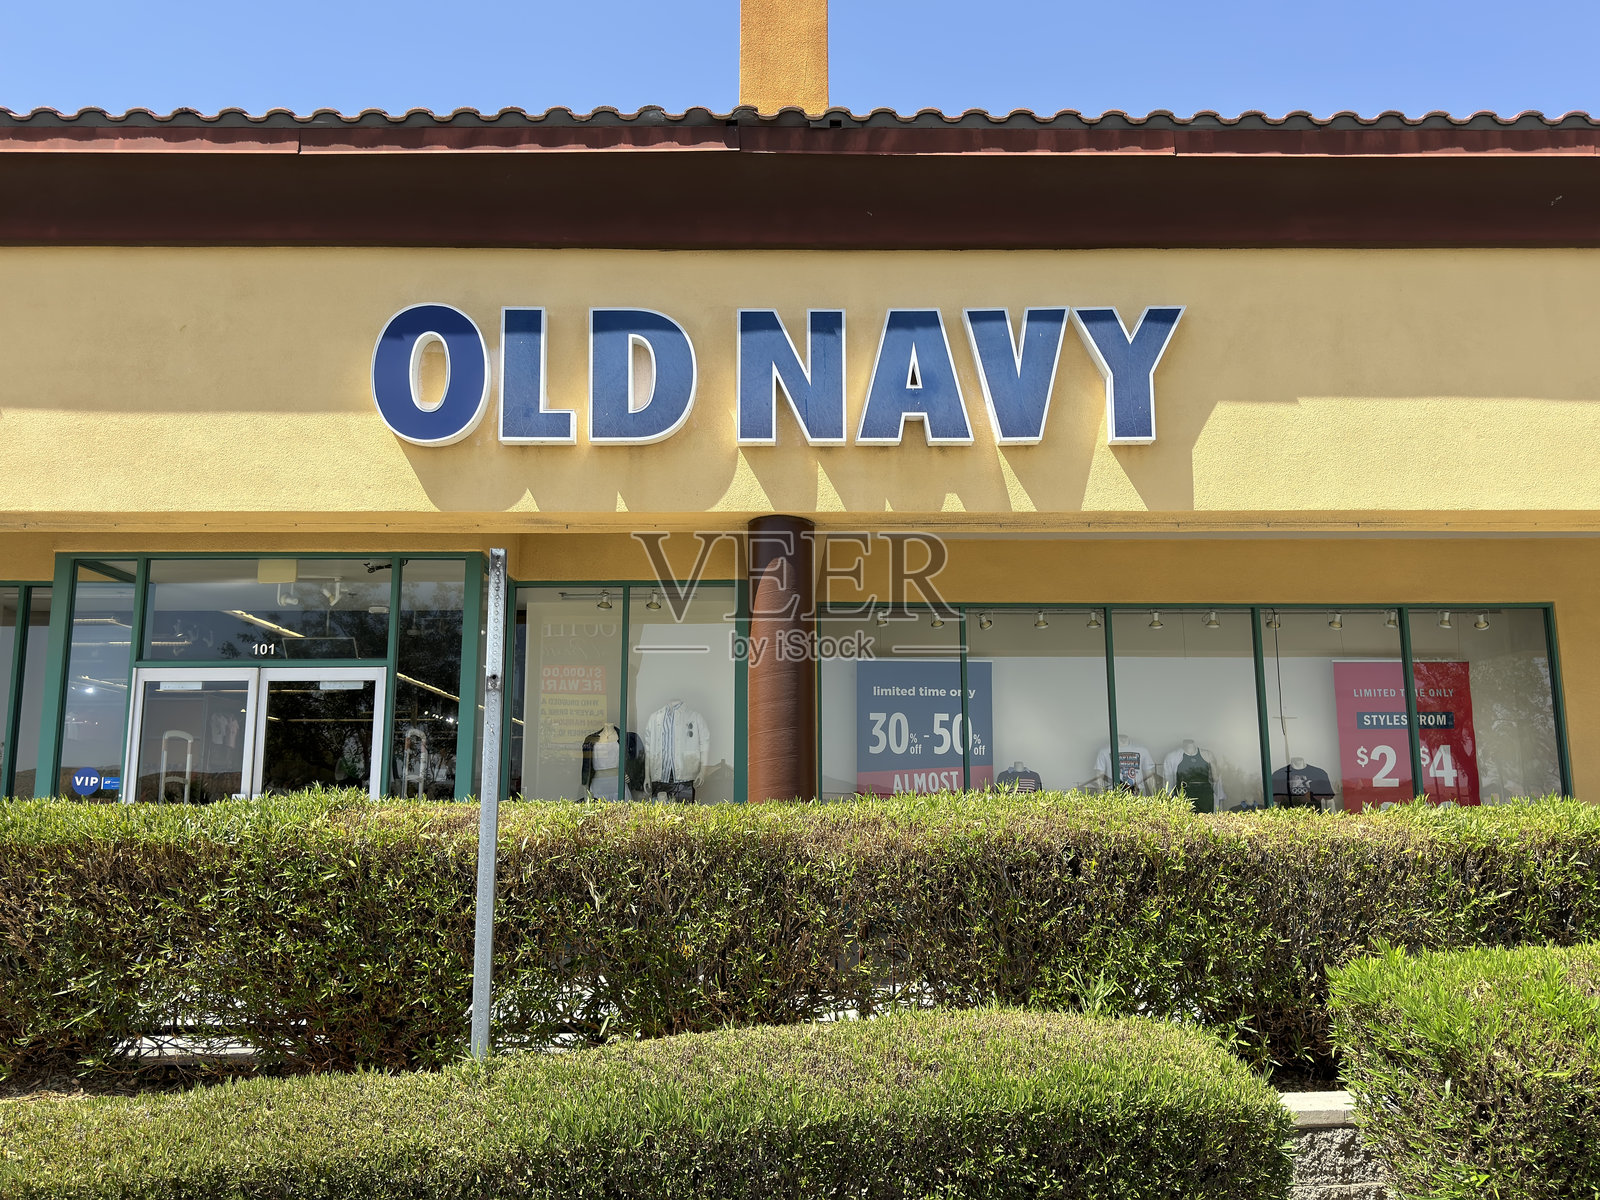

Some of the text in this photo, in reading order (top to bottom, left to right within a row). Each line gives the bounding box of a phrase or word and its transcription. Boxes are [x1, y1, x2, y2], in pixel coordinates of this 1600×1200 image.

[371, 302, 1187, 447] OLD NAVY
[252, 643, 275, 655] 101
[873, 686, 916, 696] limited
[919, 686, 947, 697] time
[1353, 688, 1396, 698] LIMITED
[1428, 688, 1454, 698] ONLY
[1363, 714, 1447, 726] STYLES ROM
[909, 744, 922, 755] off
[973, 745, 986, 756] off
[1356, 745, 1400, 788] $2
[74, 776, 99, 787] VIP
[893, 771, 959, 795] ALMOST
